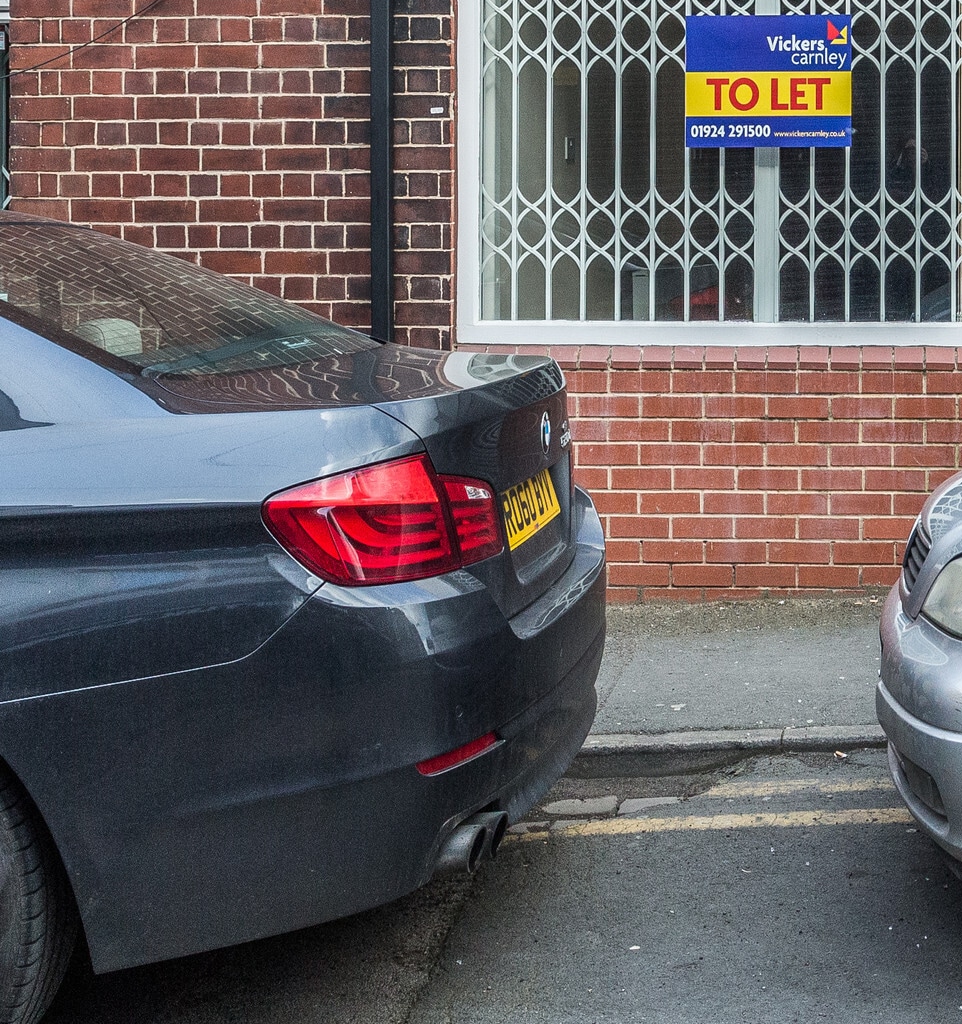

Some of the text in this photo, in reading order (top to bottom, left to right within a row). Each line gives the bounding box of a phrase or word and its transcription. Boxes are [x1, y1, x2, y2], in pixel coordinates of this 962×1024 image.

[767, 35, 825, 51] Vickers
[791, 48, 847, 69] carnley
[706, 77, 831, 111] TO LET
[690, 125, 845, 138] 01924 291500 www.vickerscarnley.co.uk
